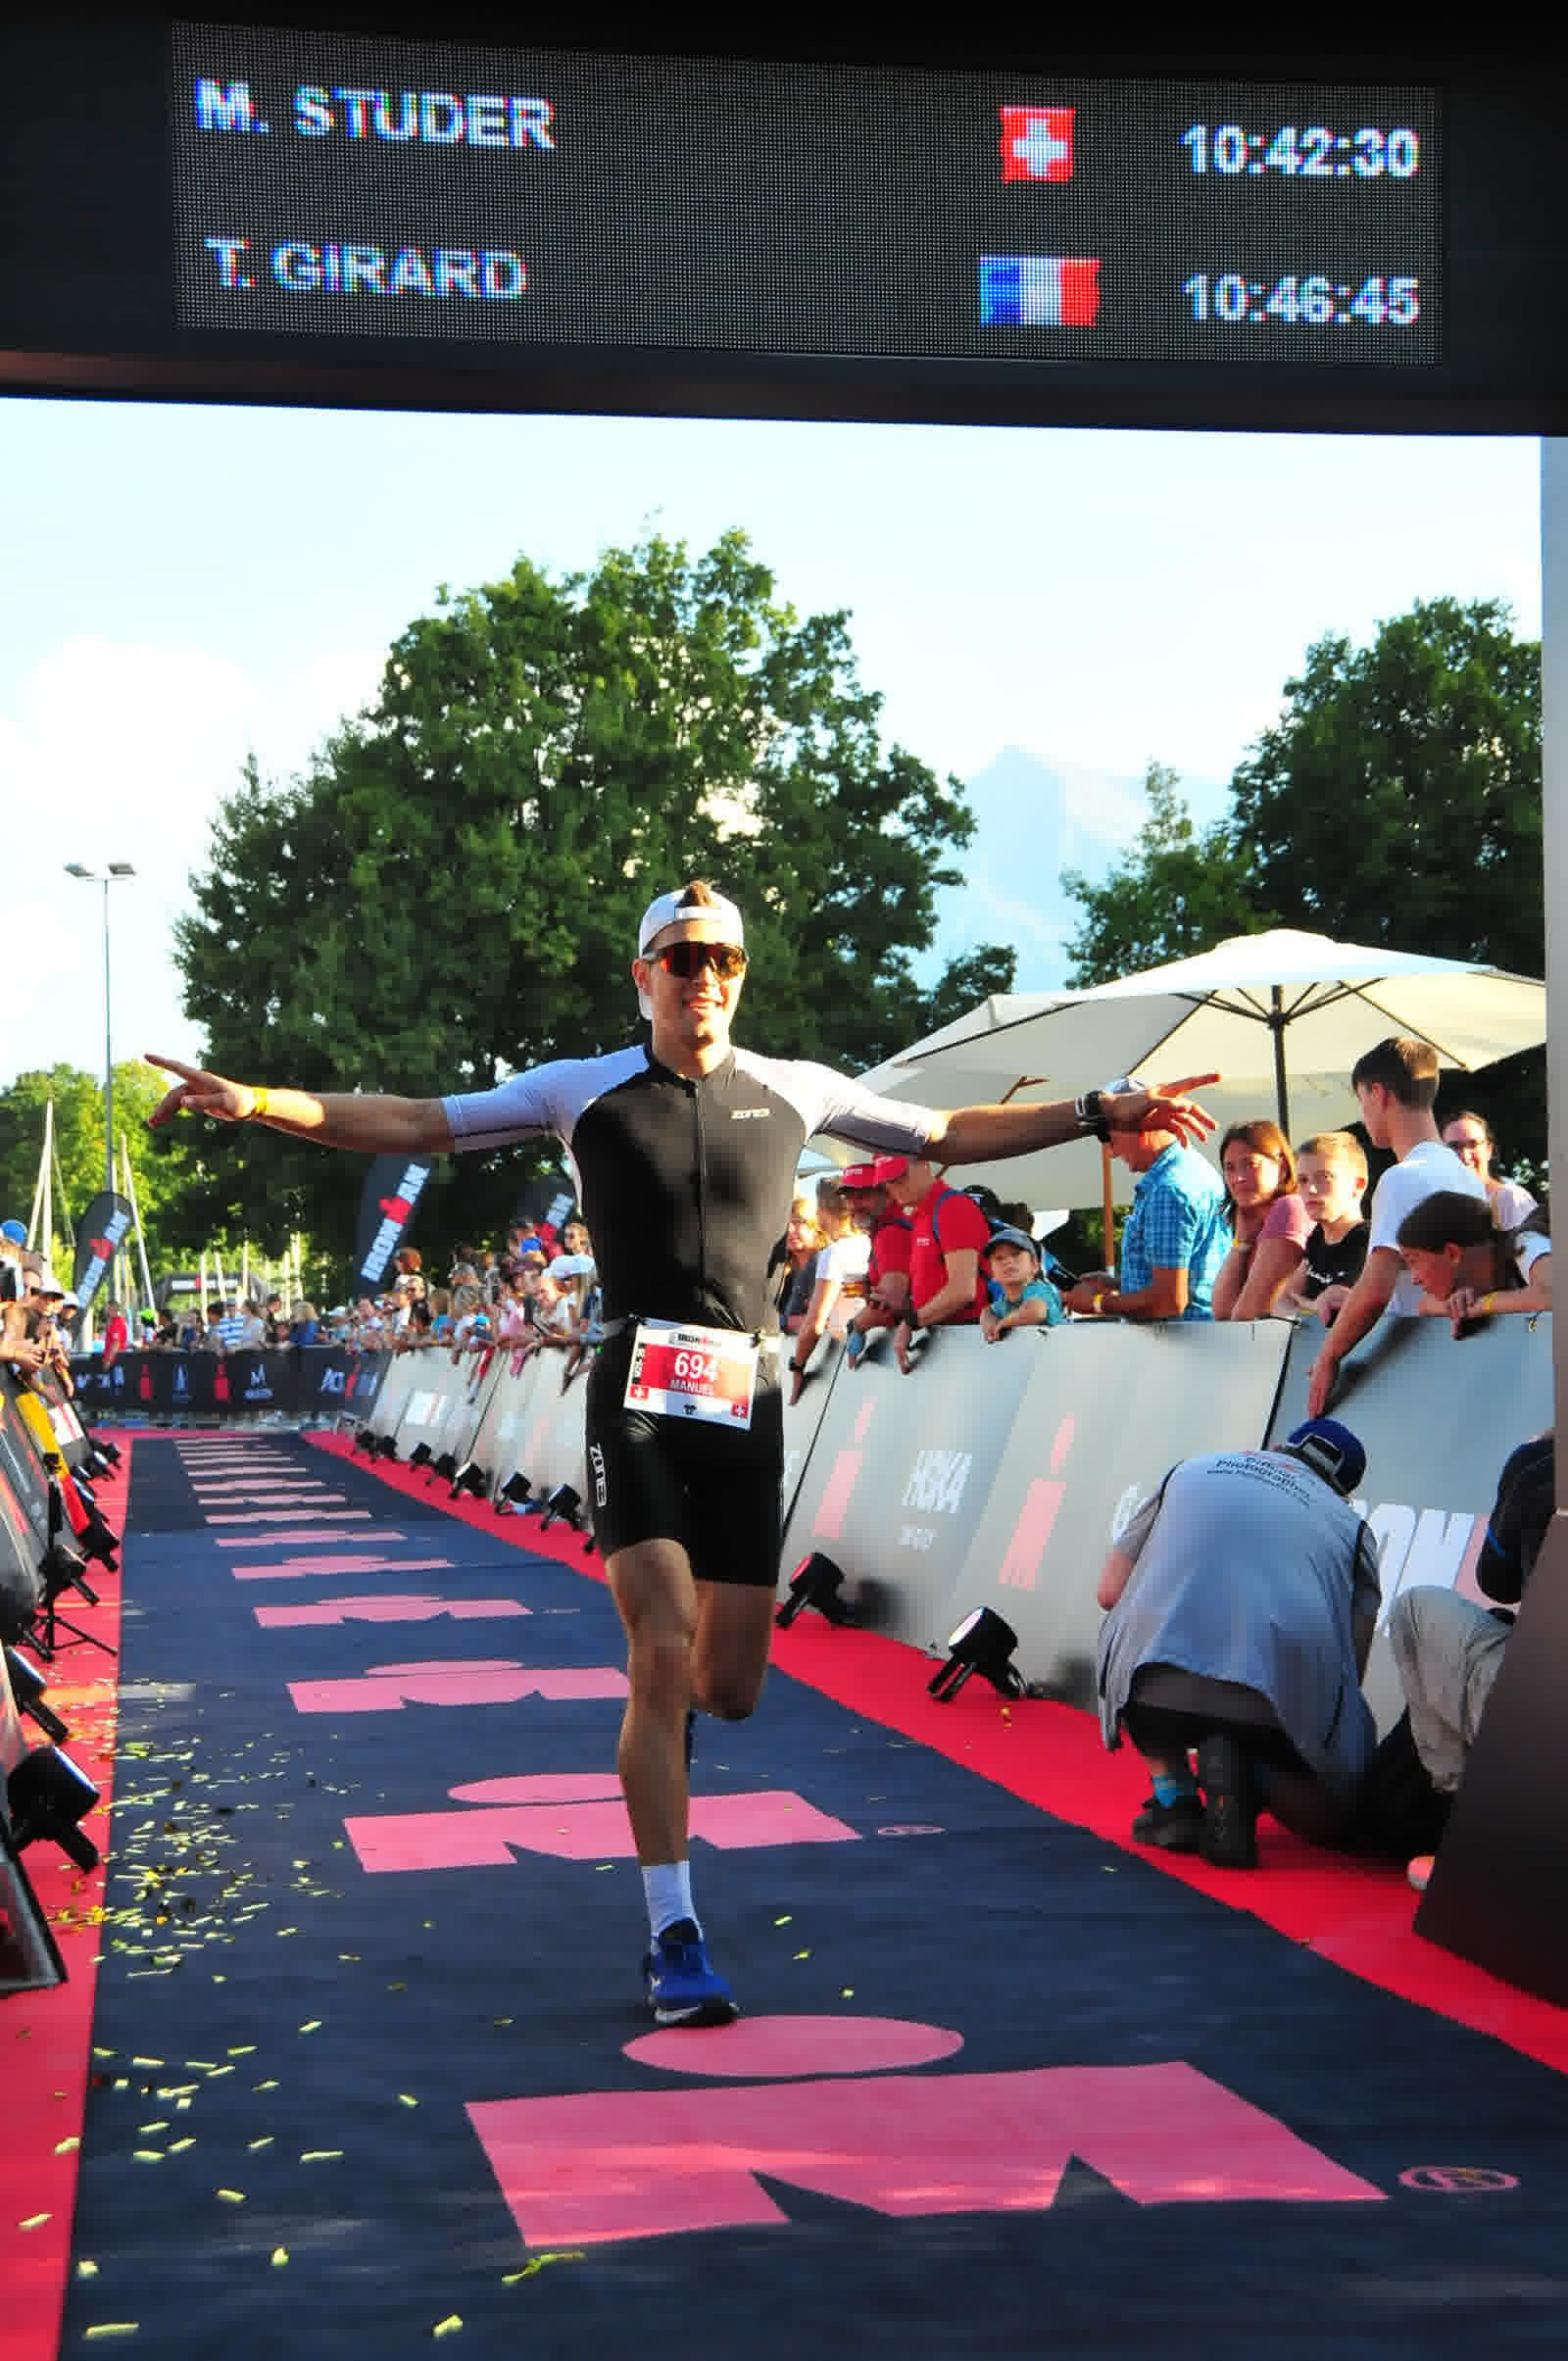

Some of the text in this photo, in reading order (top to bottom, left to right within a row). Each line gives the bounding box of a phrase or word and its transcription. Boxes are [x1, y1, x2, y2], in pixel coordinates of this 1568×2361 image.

[195, 78, 557, 149] M. STUDER
[1179, 123, 1420, 178] 10:42:30
[203, 235, 530, 301] T. GIRARD
[1181, 272, 1421, 326] 10:46:45
[673, 1352, 718, 1382] 694
